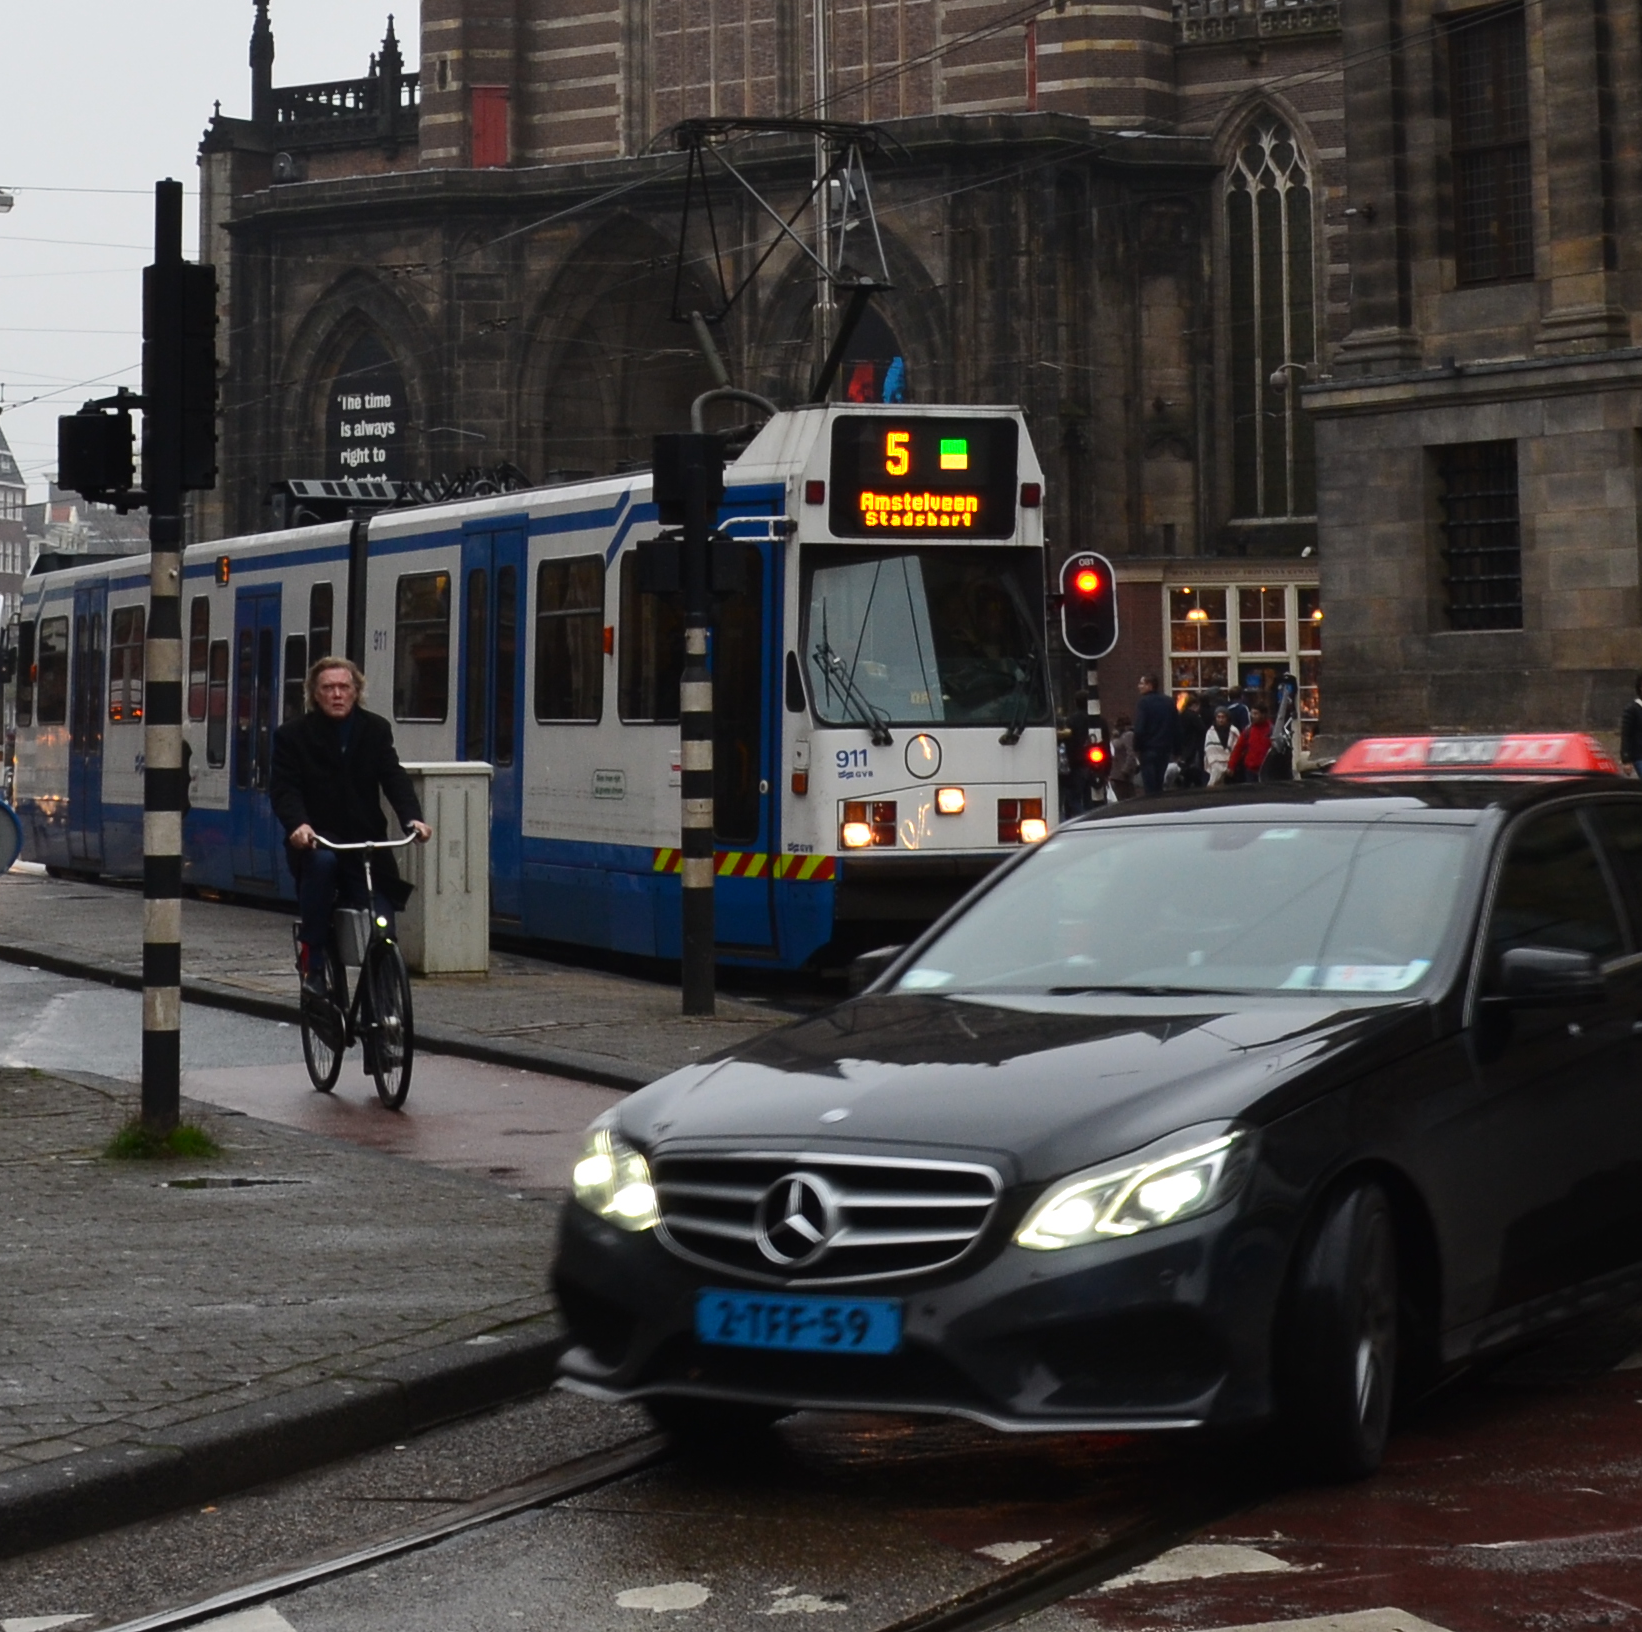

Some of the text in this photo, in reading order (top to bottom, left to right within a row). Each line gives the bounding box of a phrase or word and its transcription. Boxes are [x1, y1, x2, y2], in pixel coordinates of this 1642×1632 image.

[364, 392, 391, 409] time
[340, 420, 395, 438] is always
[341, 447, 386, 467] right to
[885, 431, 910, 476] 5
[860, 492, 978, 512] Amstelveen
[373, 631, 388, 652] 911
[835, 748, 868, 769] 911
[1428, 741, 1496, 764] TAXI
